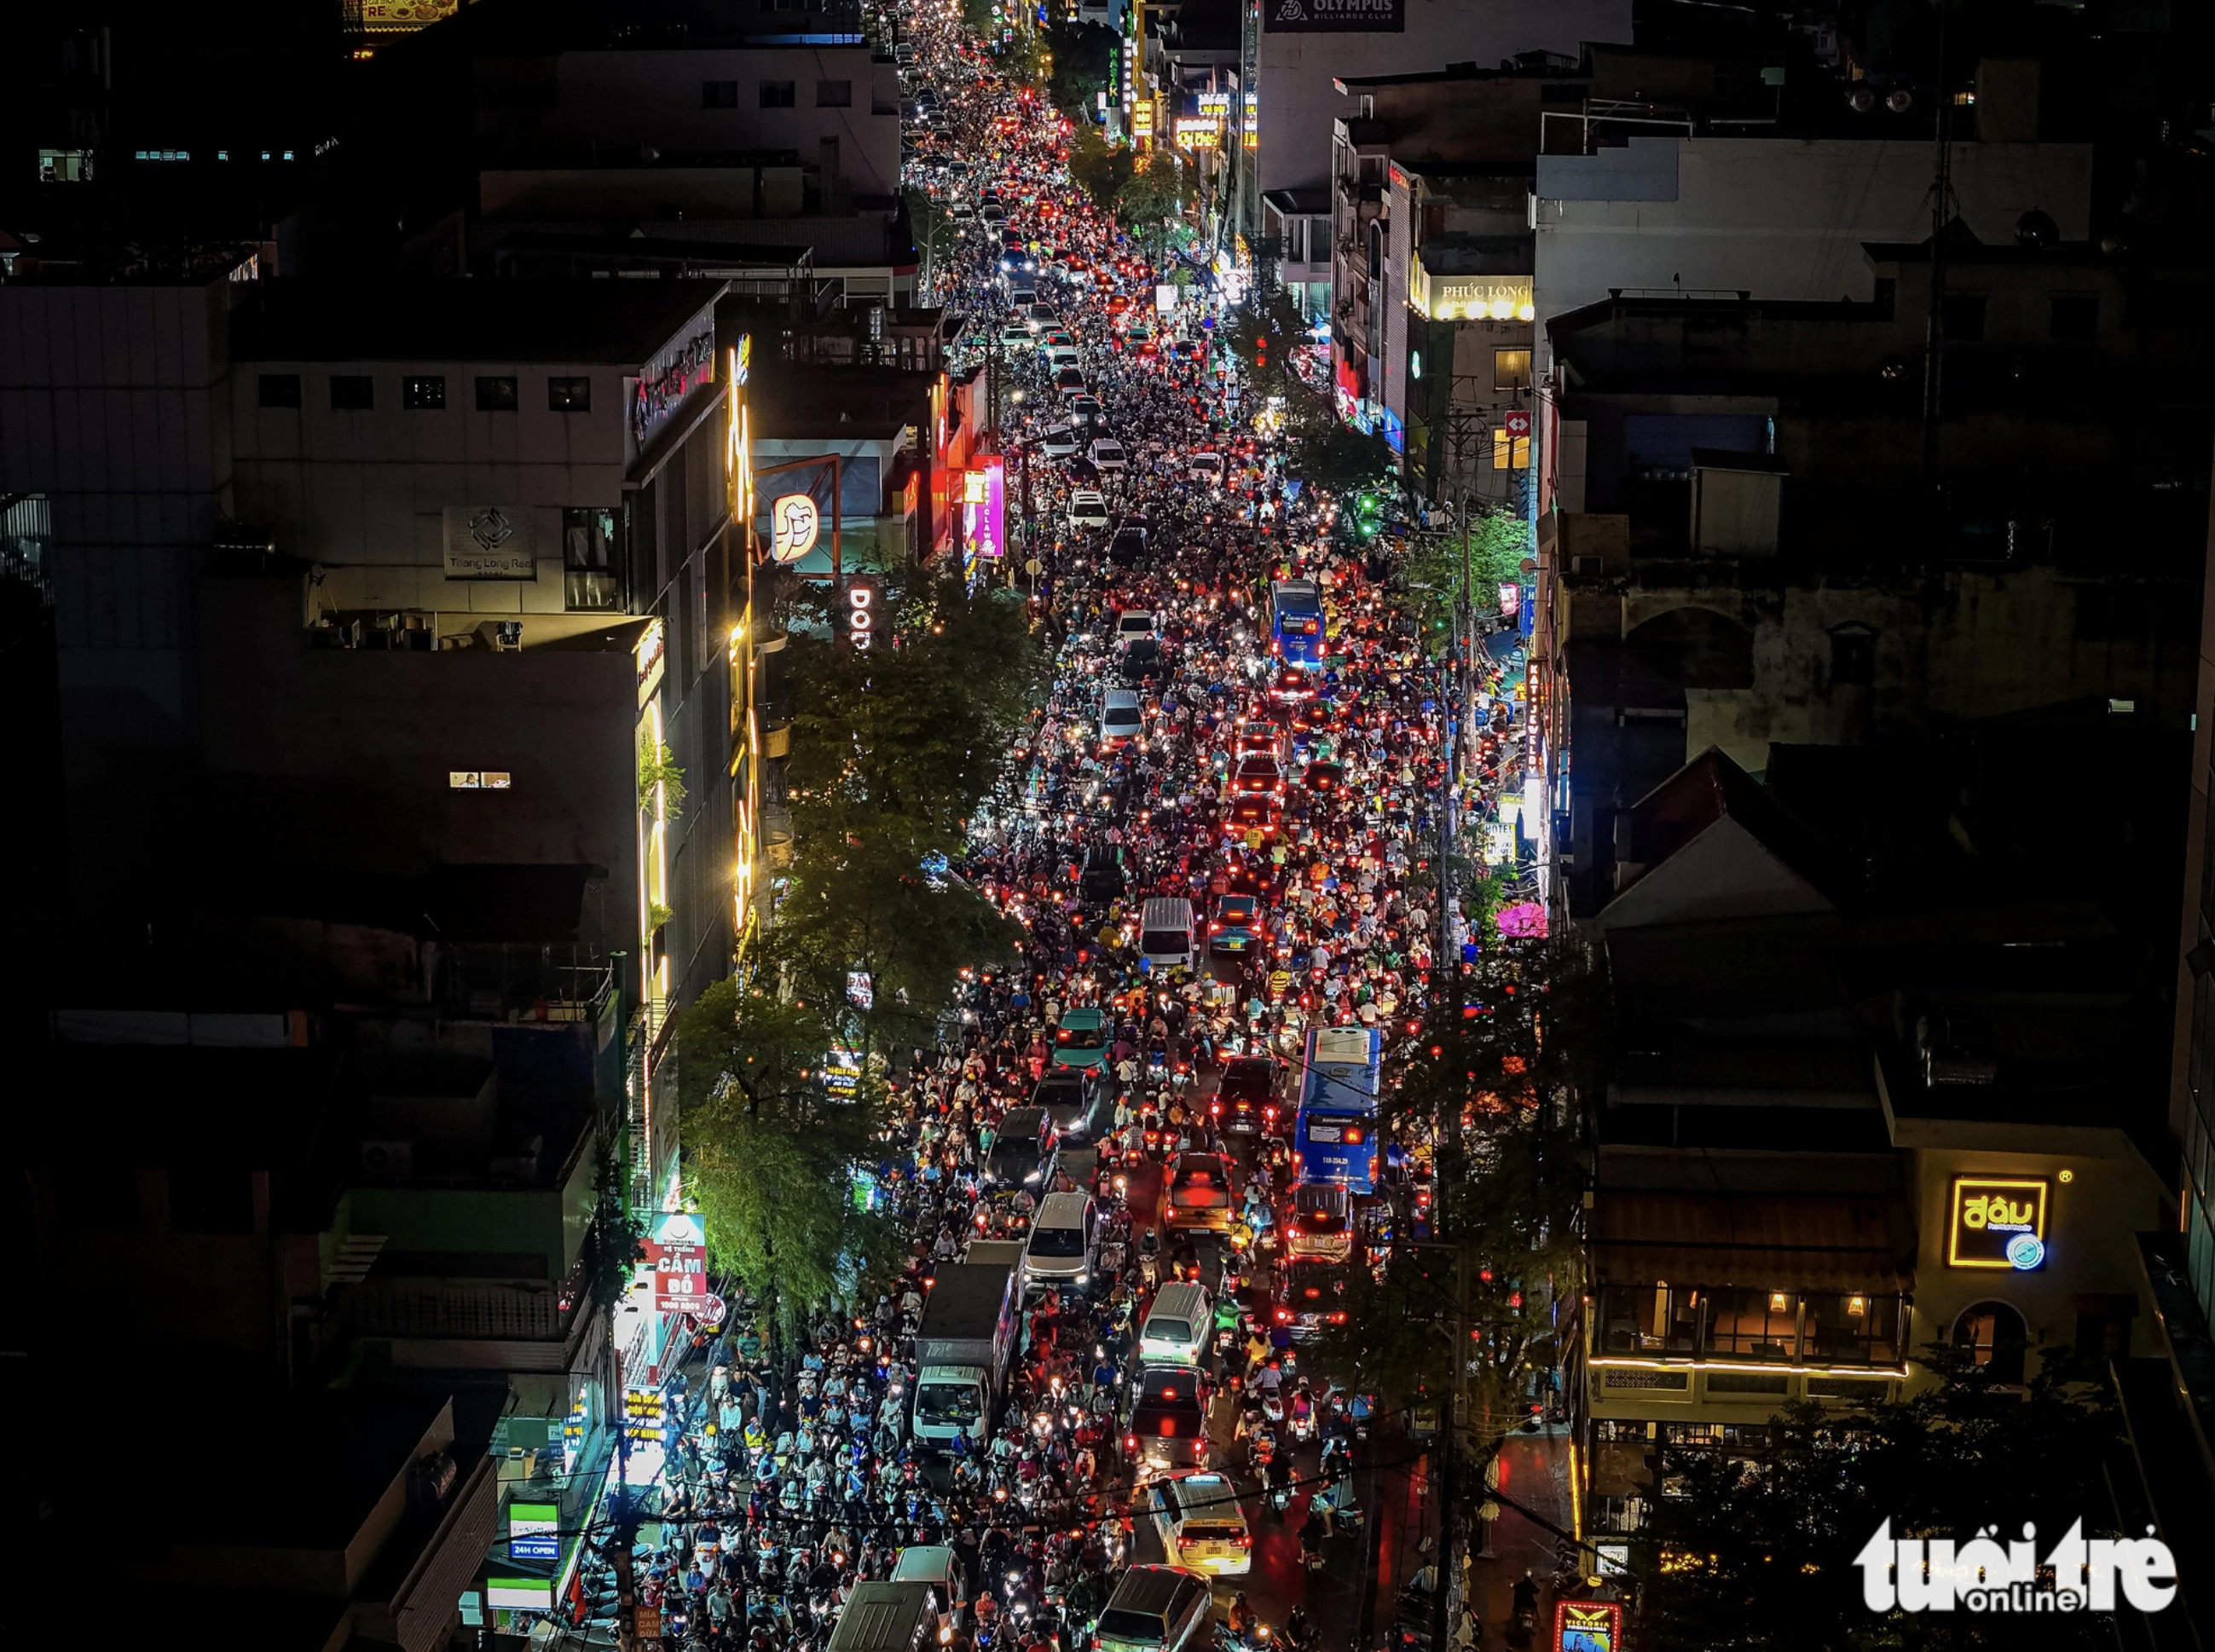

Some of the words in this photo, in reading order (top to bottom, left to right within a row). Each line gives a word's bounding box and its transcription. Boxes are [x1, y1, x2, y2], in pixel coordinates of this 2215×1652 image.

[1109, 48, 1119, 106] HASAKI
[1443, 282, 1484, 297] PHÚC
[1488, 286, 1529, 297] LONG
[484, 558, 509, 570] Long
[1485, 824, 1512, 834] HOTEL
[532, 1546, 555, 1555] OPEN
[639, 1609, 656, 1619] MÍA
[639, 1620, 660, 1629] CAM
